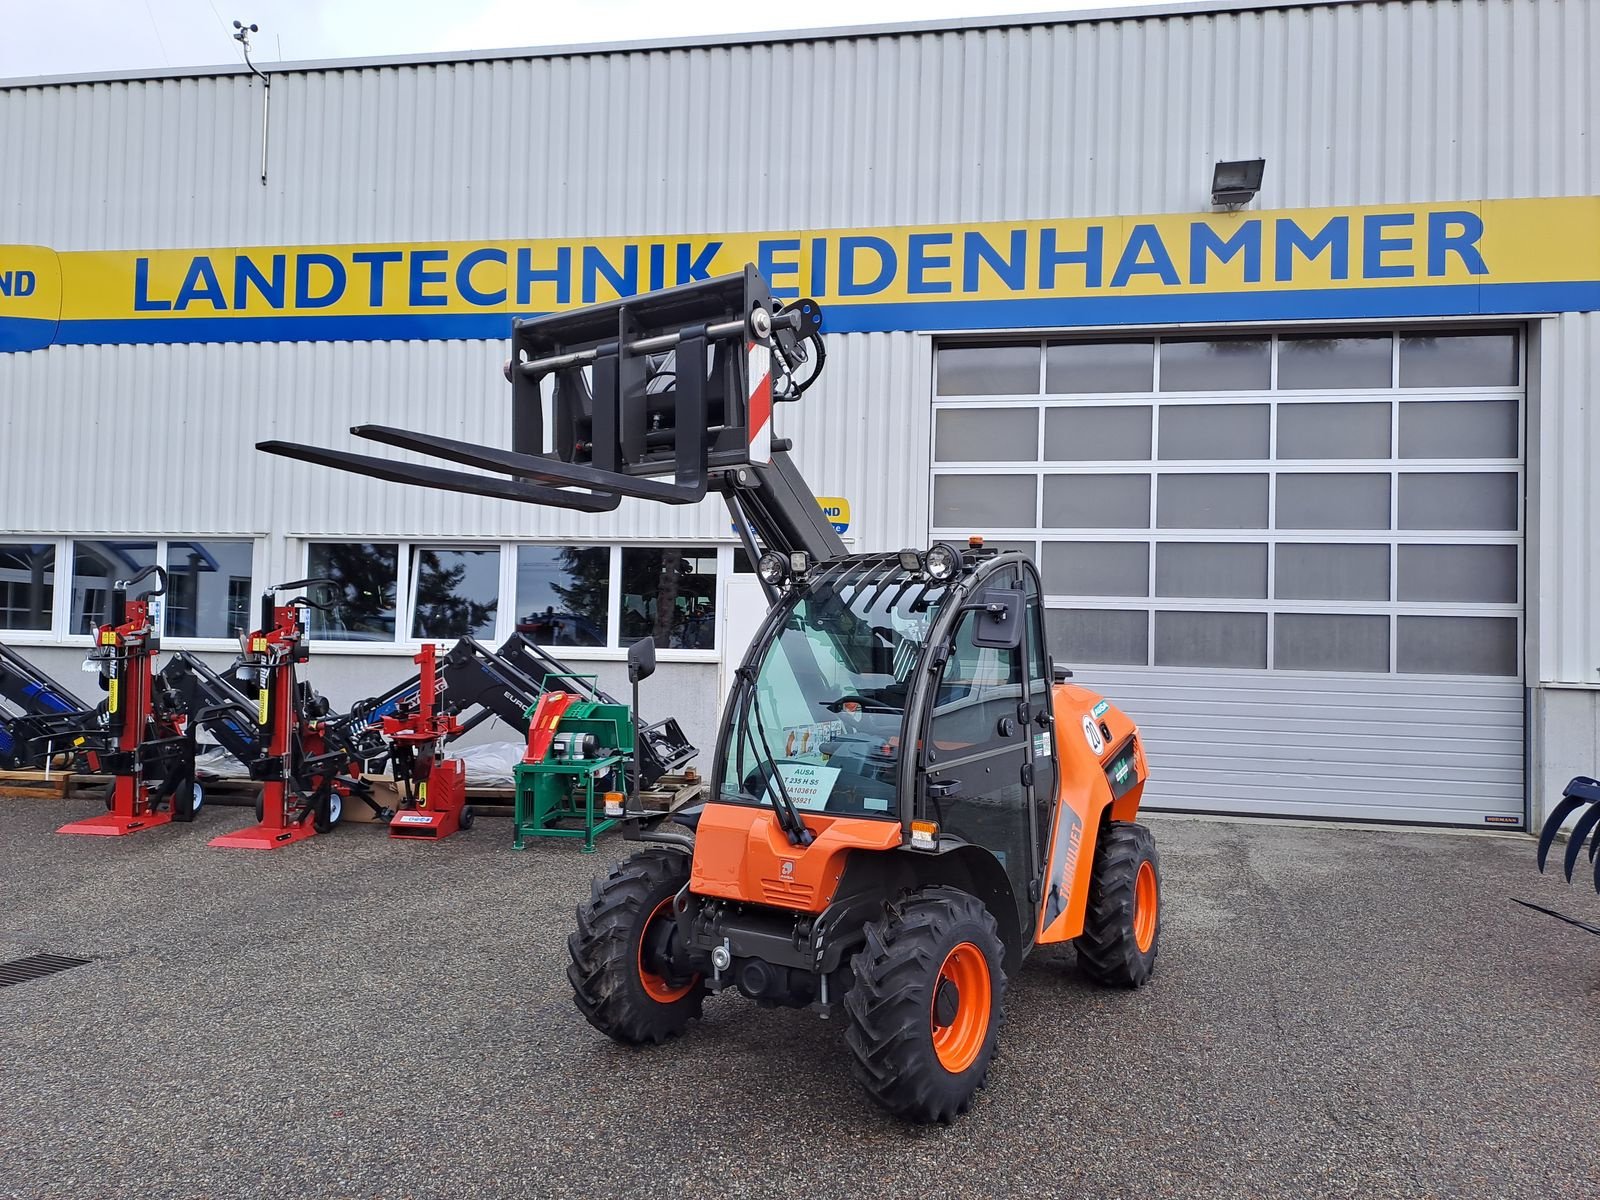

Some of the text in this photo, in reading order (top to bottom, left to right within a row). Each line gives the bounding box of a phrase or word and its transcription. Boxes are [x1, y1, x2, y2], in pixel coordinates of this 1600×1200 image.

[134, 211, 1490, 311] LANDTECHNIK EIDENHAMMER
[1086, 721, 1101, 749] 20
